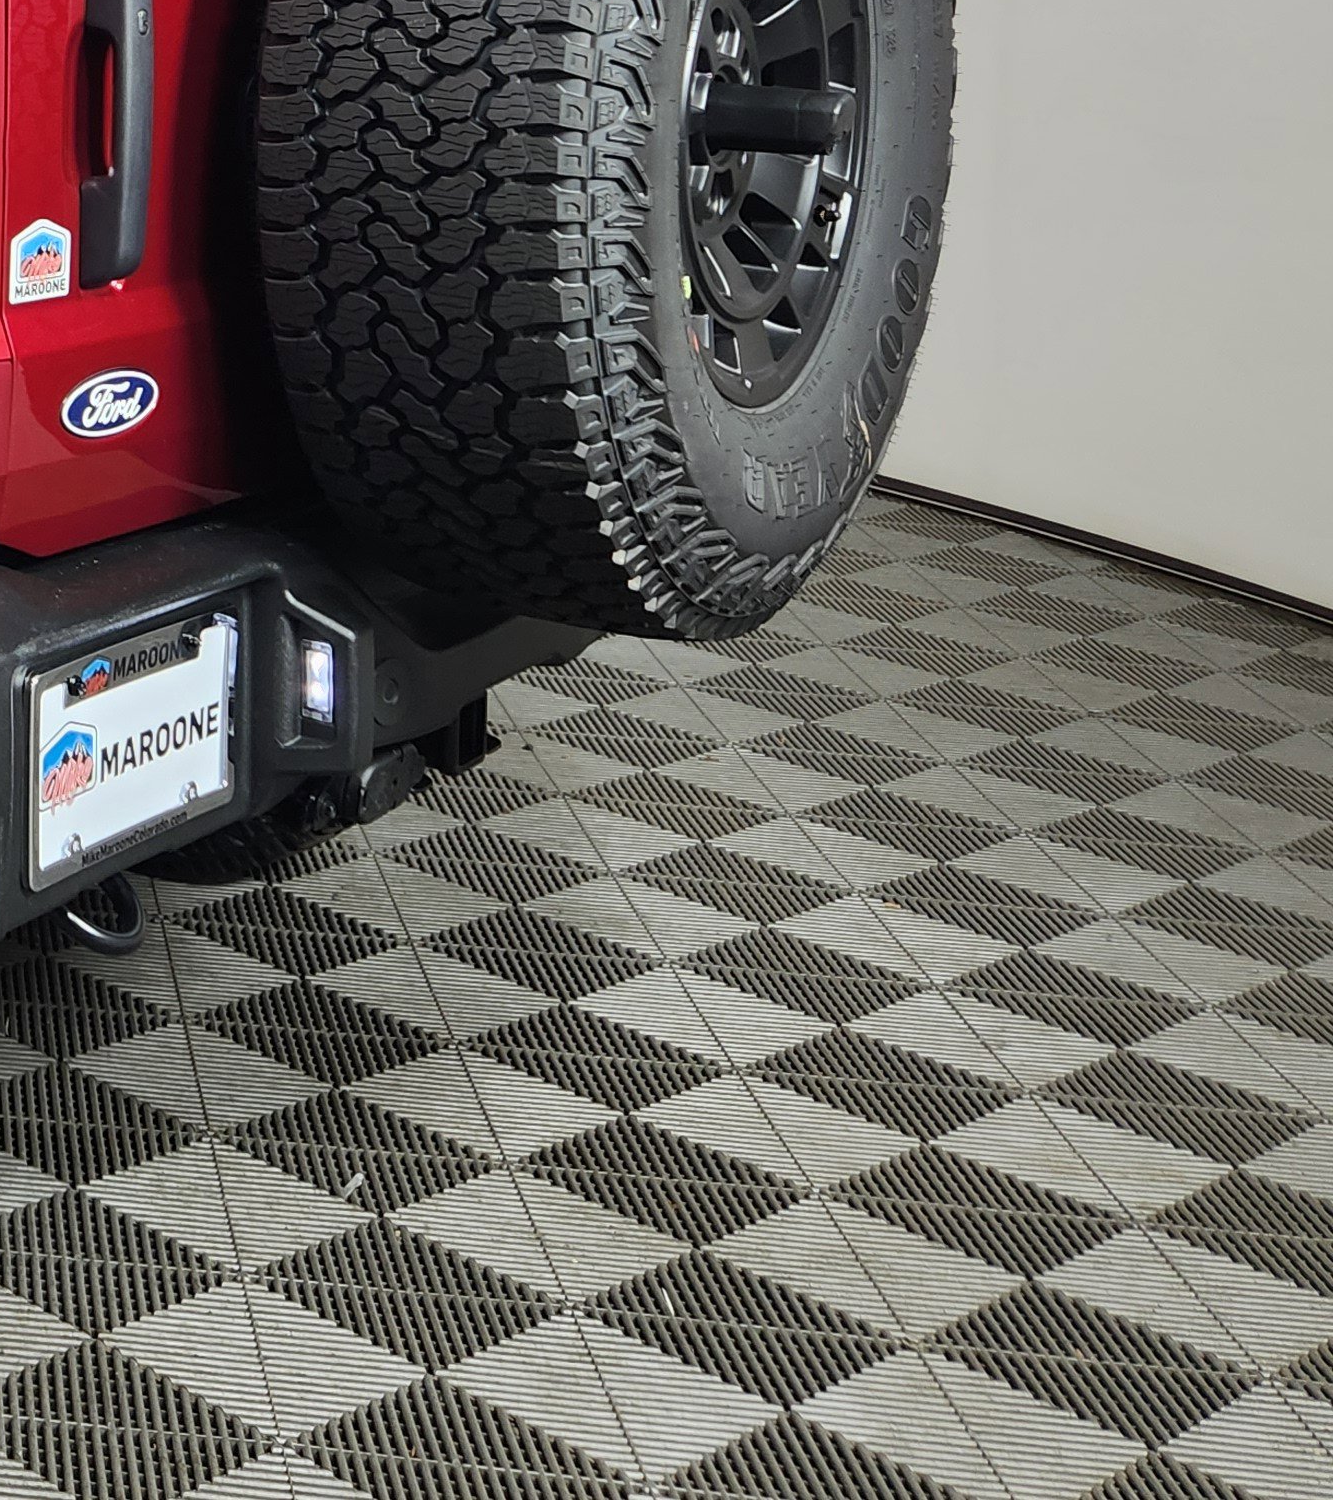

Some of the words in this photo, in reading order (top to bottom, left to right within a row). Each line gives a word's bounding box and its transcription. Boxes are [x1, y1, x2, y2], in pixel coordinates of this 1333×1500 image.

[14, 278, 66, 298] MAROONE
[83, 380, 144, 429] Ford
[100, 702, 219, 783] MAROONE
